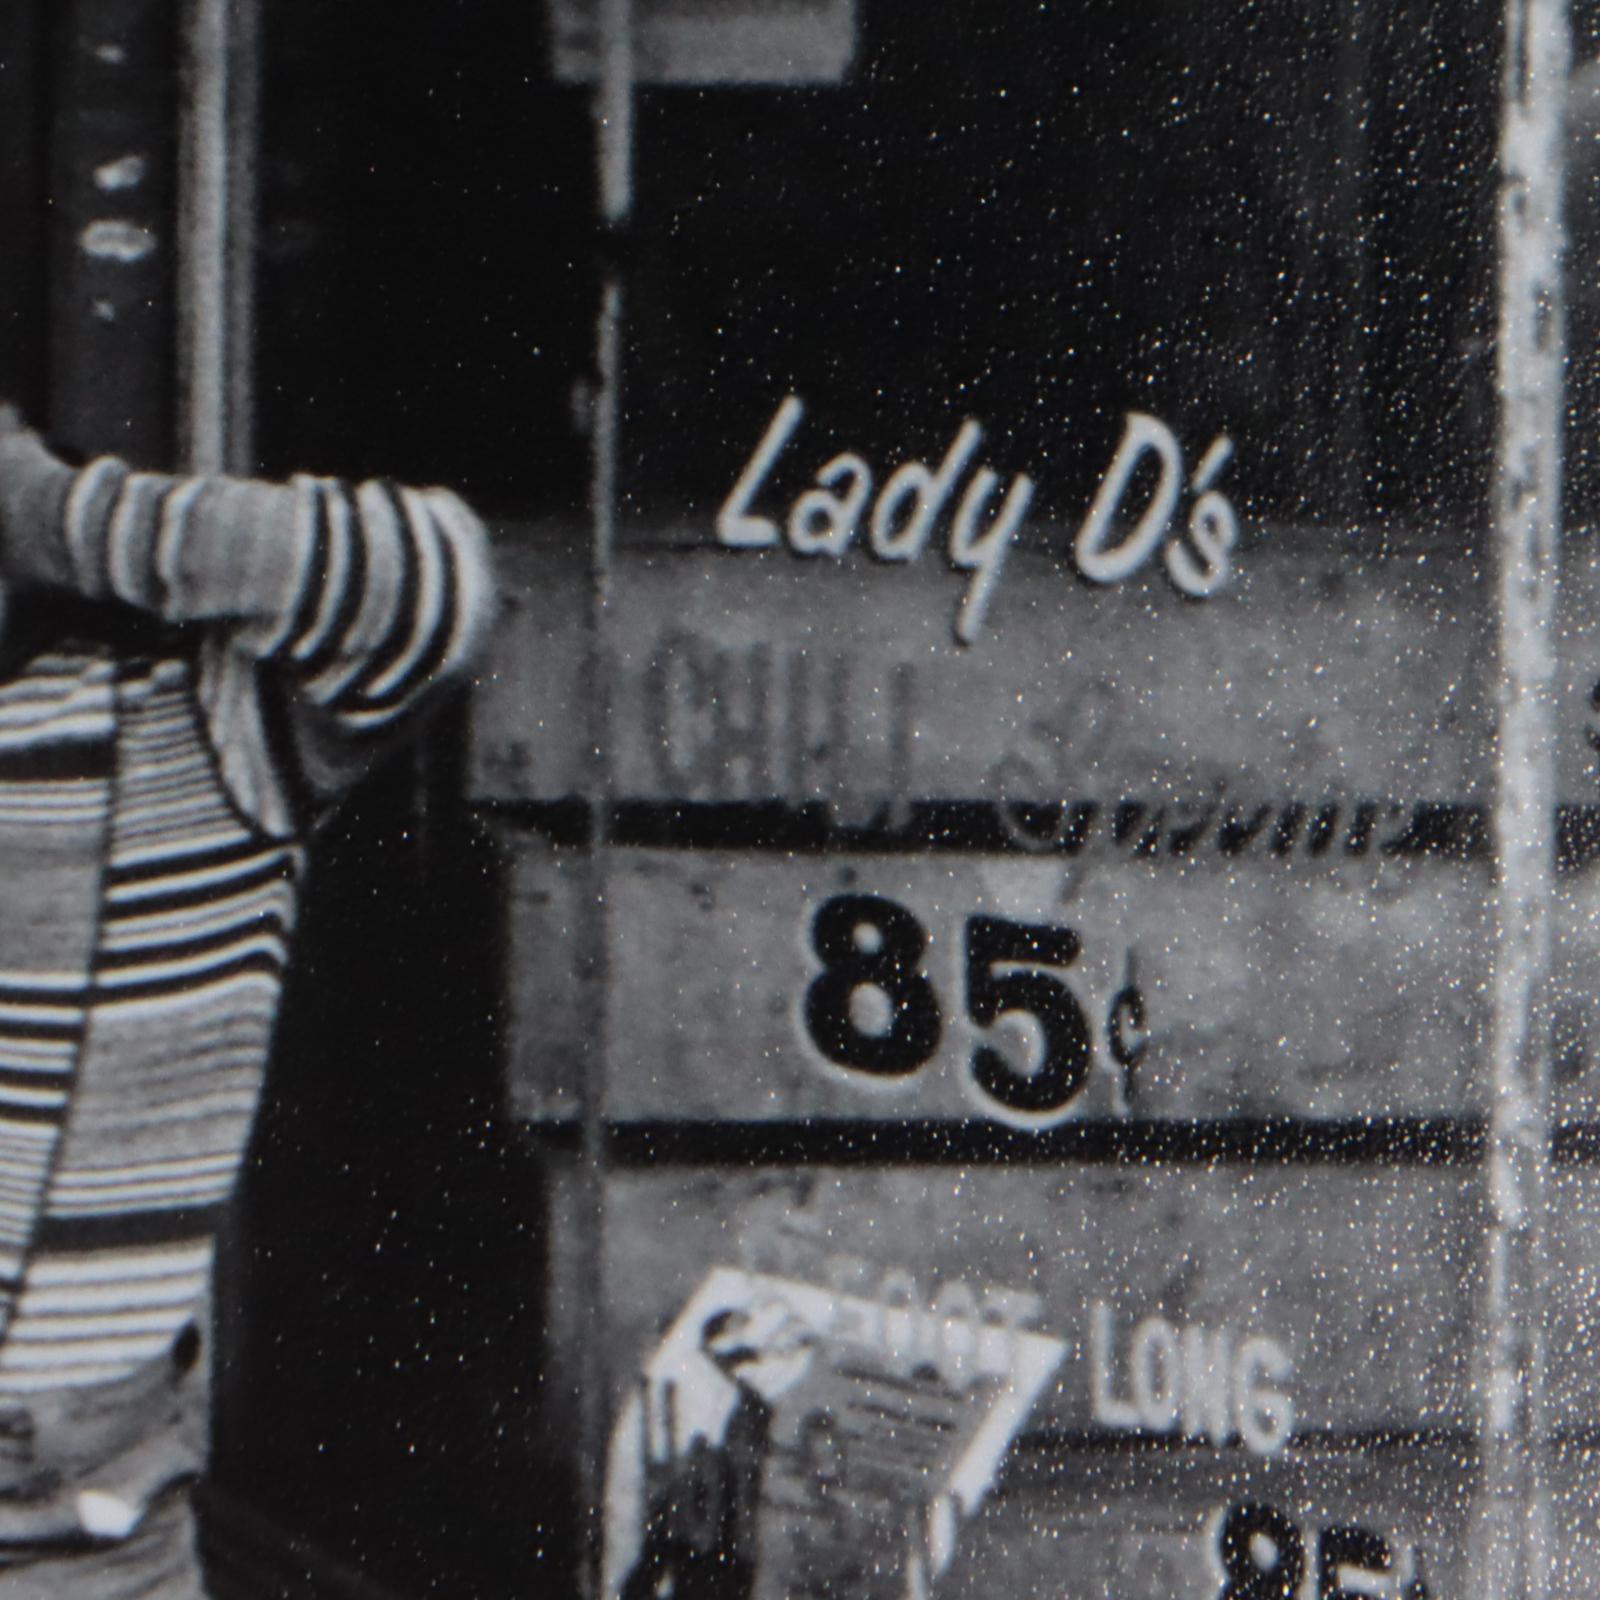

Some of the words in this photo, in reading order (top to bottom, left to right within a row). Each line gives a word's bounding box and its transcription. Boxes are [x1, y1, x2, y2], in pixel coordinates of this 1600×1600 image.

[716, 394, 1032, 646] Lady
[1074, 412, 1236, 596] D's
[1086, 1302, 1296, 1454] LONG
